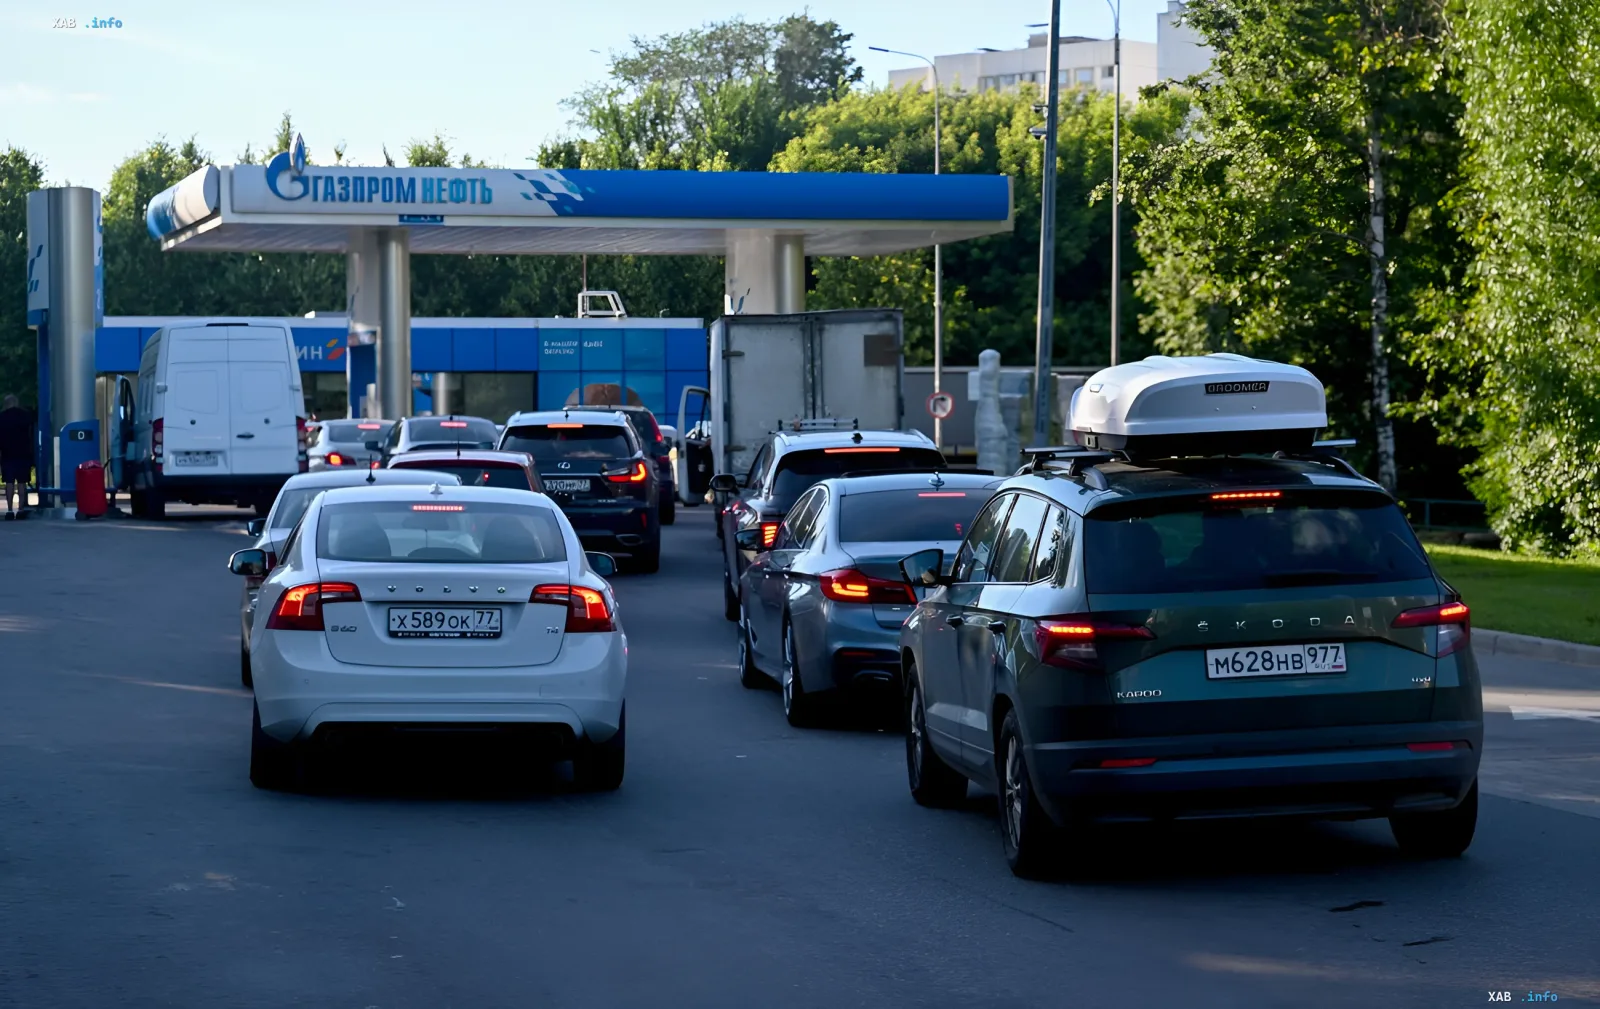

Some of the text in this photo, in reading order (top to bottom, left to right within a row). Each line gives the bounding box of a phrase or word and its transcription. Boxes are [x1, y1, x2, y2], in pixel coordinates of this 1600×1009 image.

[311, 176, 493, 205] ГАЗПРОМ НЕФТЬ
[387, 585, 506, 594] VOLVO
[476, 611, 494, 625] 77
[1214, 646, 1341, 675] М628НВ 977
